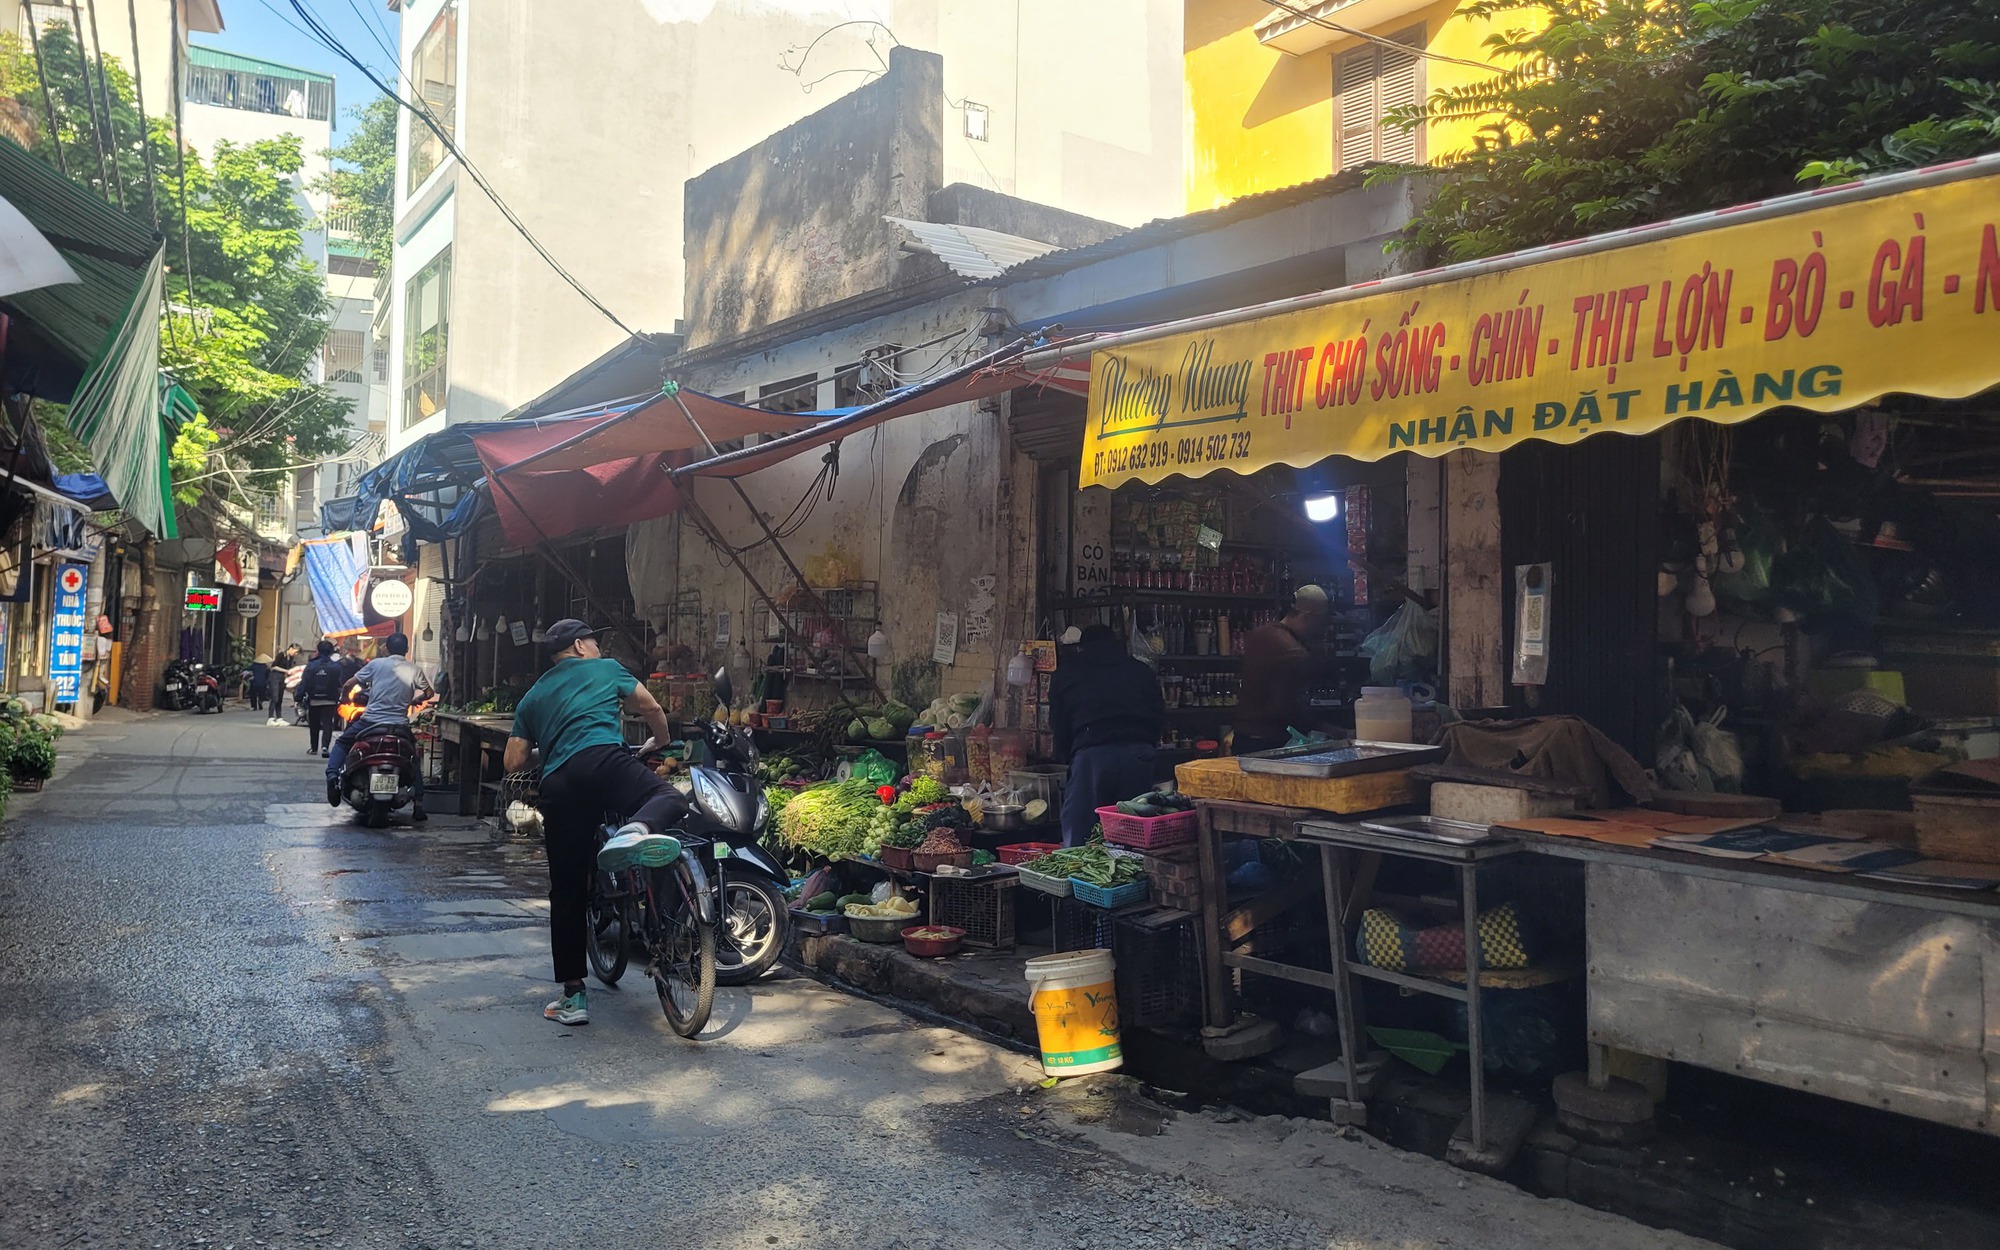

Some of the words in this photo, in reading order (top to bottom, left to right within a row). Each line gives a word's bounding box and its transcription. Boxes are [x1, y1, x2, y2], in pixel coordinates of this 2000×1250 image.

[1261, 346, 1315, 430] THỊT
[1315, 318, 1368, 410] CHÓ
[1371, 300, 1446, 402] SỐNG
[1468, 288, 1544, 387] CHÍN
[1570, 284, 1649, 384] THỊT
[1652, 260, 1733, 372] LỢN
[1764, 231, 1826, 341] BÒ
[1867, 212, 1926, 329] GÀ
[1178, 338, 1253, 423] Nhung
[1388, 405, 1514, 449] NHẬN
[1532, 389, 1641, 433] ĐẶT
[1664, 364, 1843, 414] HÀNG
[1094, 452, 1106, 477] ĐT:
[1107, 446, 1127, 474] 0912
[1129, 443, 1148, 469] 632
[1150, 440, 1169, 467] 919
[1177, 436, 1203, 465] 0914
[1205, 433, 1228, 461] 502
[1229, 430, 1251, 459] 732
[1082, 542, 1103, 560] CÓ
[1077, 563, 1108, 582] BÁN
[63, 594, 80, 608] NHÀ
[57, 610, 82, 627] THUỐC
